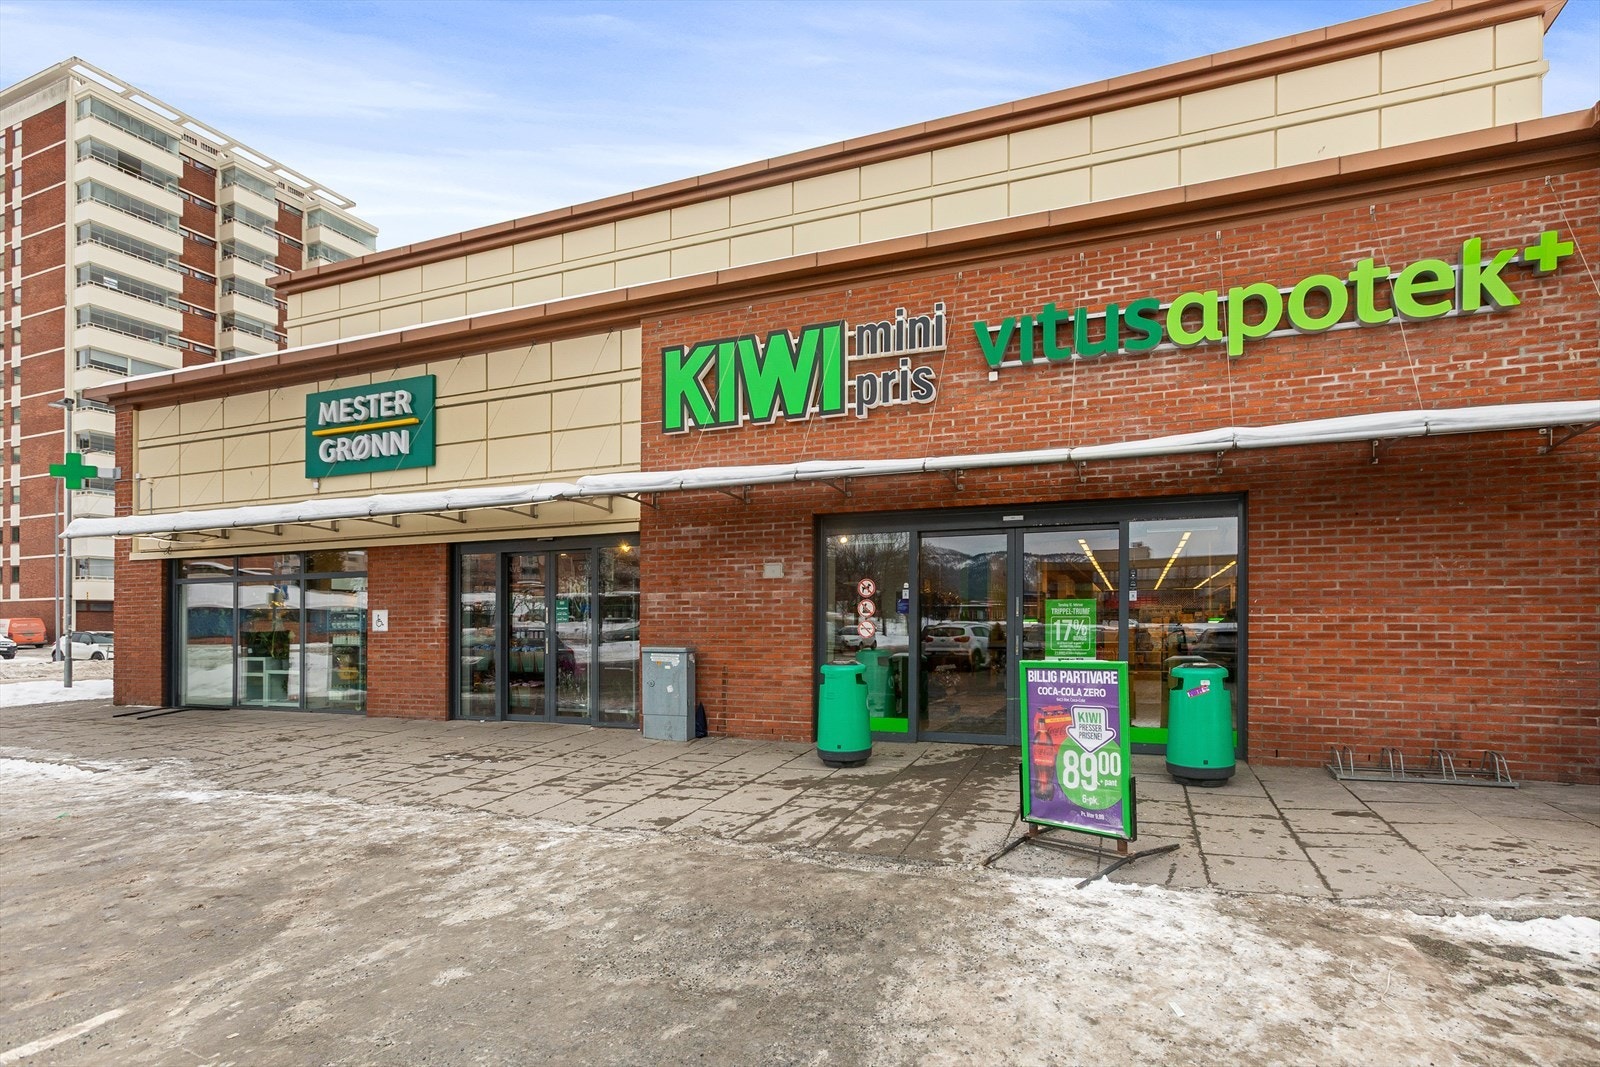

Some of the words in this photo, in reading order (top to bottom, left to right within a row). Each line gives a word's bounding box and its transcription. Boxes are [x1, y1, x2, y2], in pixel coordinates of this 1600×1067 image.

[855, 301, 947, 358] mini
[661, 319, 849, 435] KIWI
[855, 357, 937, 420] pris
[318, 389, 412, 425] MESTER
[319, 429, 410, 463] GRØNN
[1051, 607, 1091, 615] TRIPPEL-TRUMF
[1053, 619, 1088, 641] 17%
[1027, 669, 1058, 683] BILLIG
[1060, 670, 1119, 685] PARTIVARE
[1037, 686, 1083, 697] COCA-COLA
[1083, 688, 1107, 698] ZERO
[1077, 711, 1102, 724] KIWI
[1078, 724, 1103, 732] PRESSER
[1078, 731, 1103, 741] PRISENE!
[1104, 779, 1118, 787] pant
